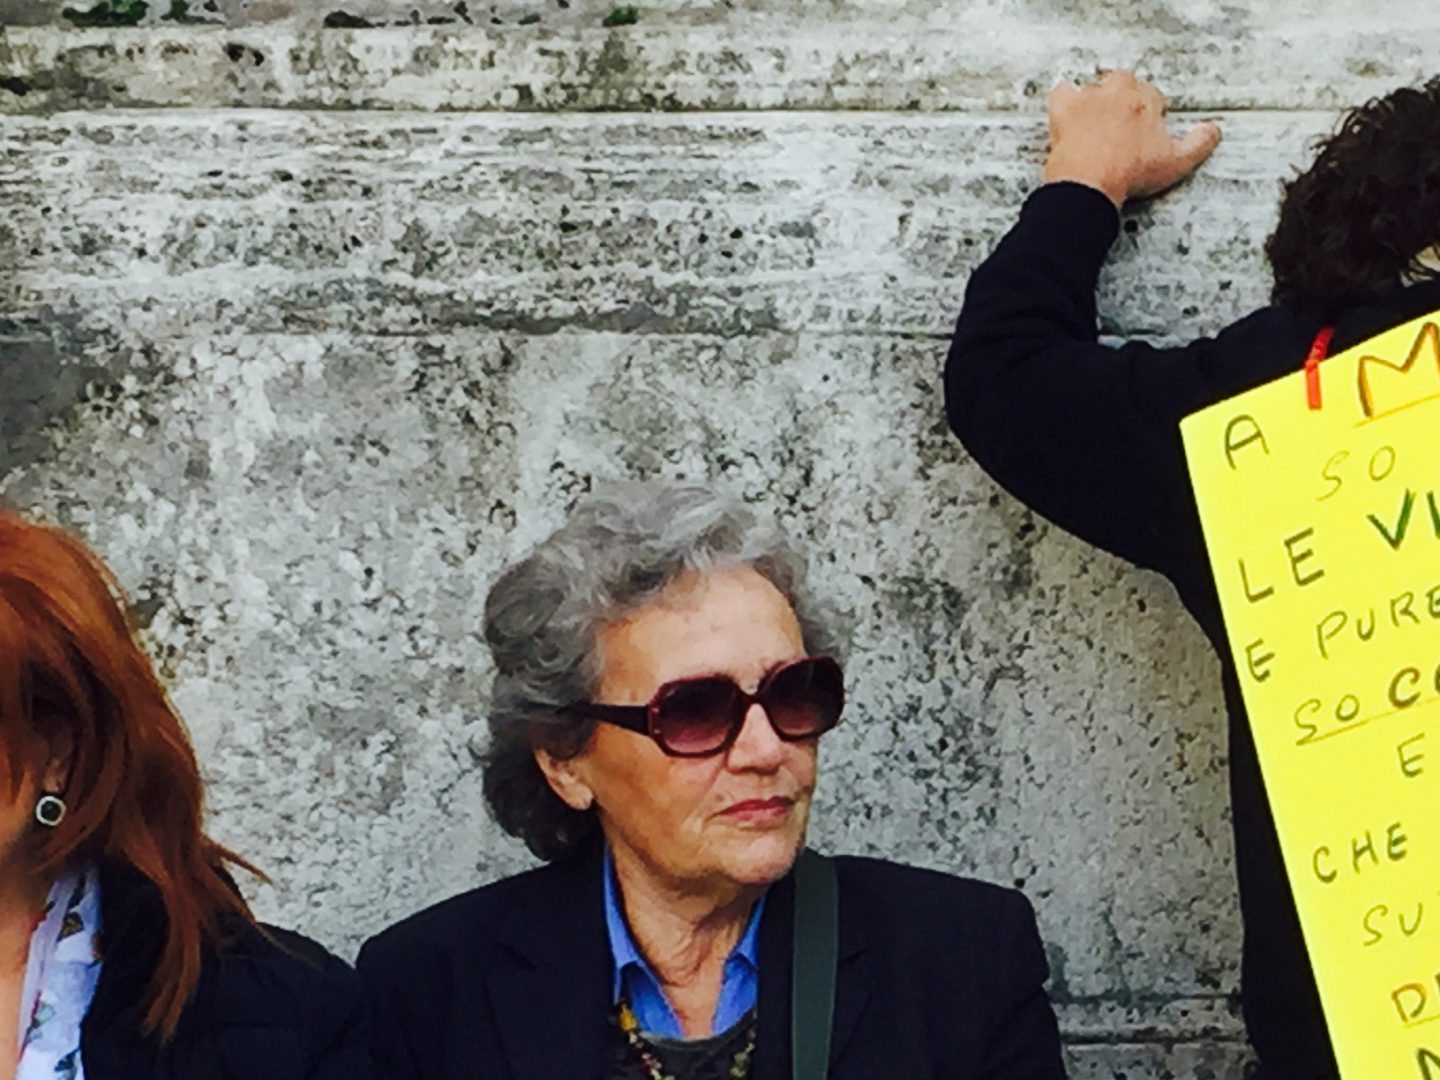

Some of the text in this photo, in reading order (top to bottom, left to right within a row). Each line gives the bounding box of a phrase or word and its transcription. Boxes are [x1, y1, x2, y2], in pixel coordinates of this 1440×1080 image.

[1223, 413, 1268, 469] A
[1317, 445, 1396, 503] SO
[1238, 527, 1325, 605] LE
[1246, 638, 1276, 684] E
[1295, 696, 1360, 744] SO
[1397, 733, 1427, 780] E
[1313, 822, 1410, 884] CHE
